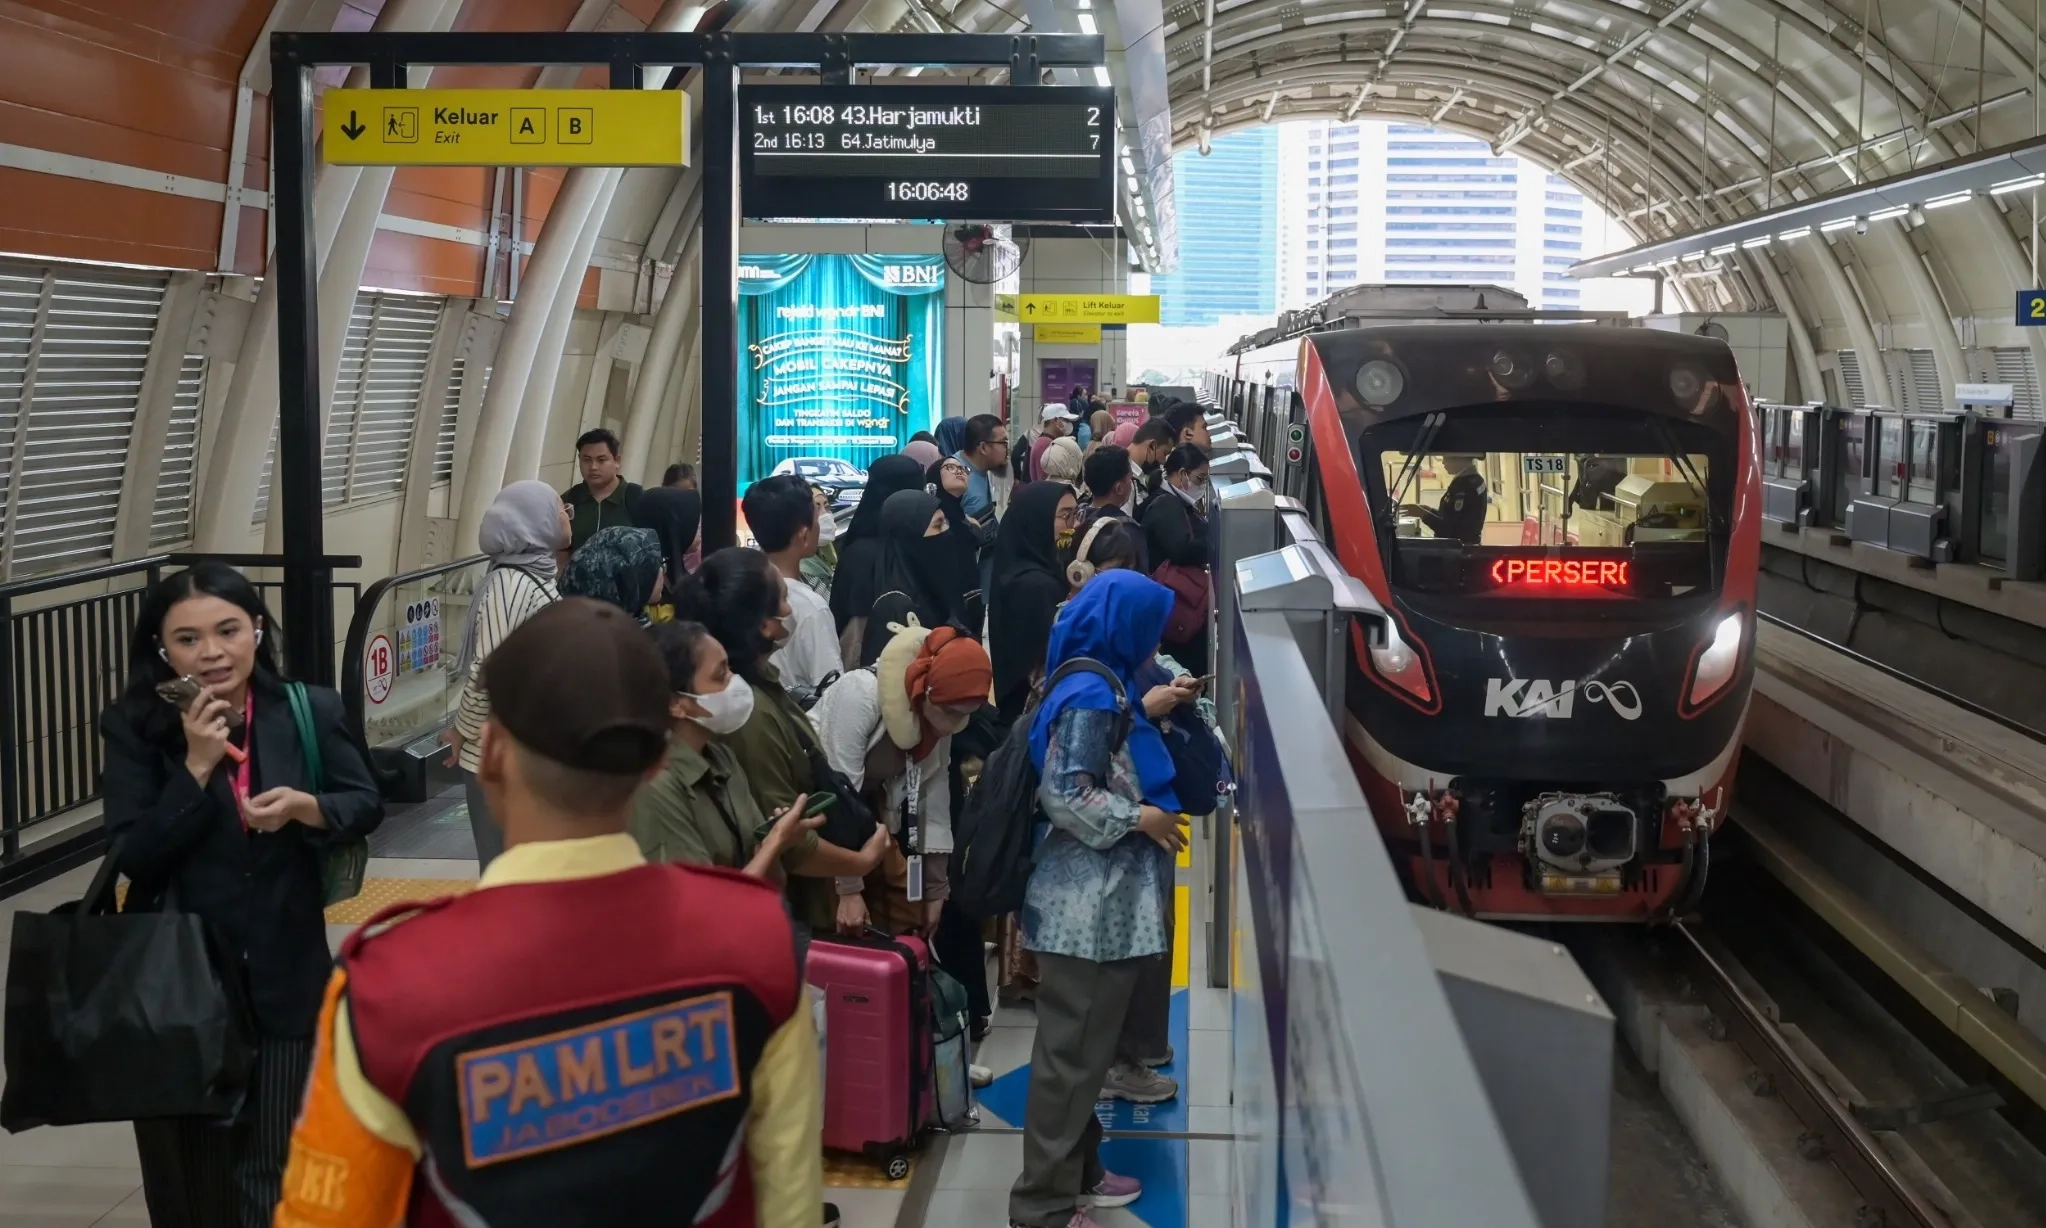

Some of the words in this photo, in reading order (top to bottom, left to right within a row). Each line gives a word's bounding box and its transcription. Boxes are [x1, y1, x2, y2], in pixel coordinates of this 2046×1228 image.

[434, 107, 499, 126] Keluar
[754, 105, 776, 125] 1st
[783, 105, 835, 125] 16:08
[1087, 107, 1100, 127] 2
[519, 117, 535, 135] A
[569, 117, 582, 135] B
[434, 131, 461, 144] Exit
[754, 133, 778, 149] 2nd
[784, 133, 825, 149] 16:13
[1089, 134, 1100, 150] 7
[887, 182, 969, 201] 16:06:48
[902, 265, 938, 283] BNI
[861, 304, 885, 318] BNI
[1083, 301, 1097, 309] Lift
[1099, 301, 1125, 309] Keluar
[2030, 297, 2046, 318] 2
[773, 358, 817, 376] MOBIL
[822, 357, 892, 377] CAKEPNYA
[773, 382, 816, 398] JANGAN
[775, 418, 795, 427] DAN
[1525, 457, 1544, 471] TS
[1546, 457, 1564, 471] 18
[371, 646, 388, 677] 1B
[1484, 678, 1576, 719] KAI
